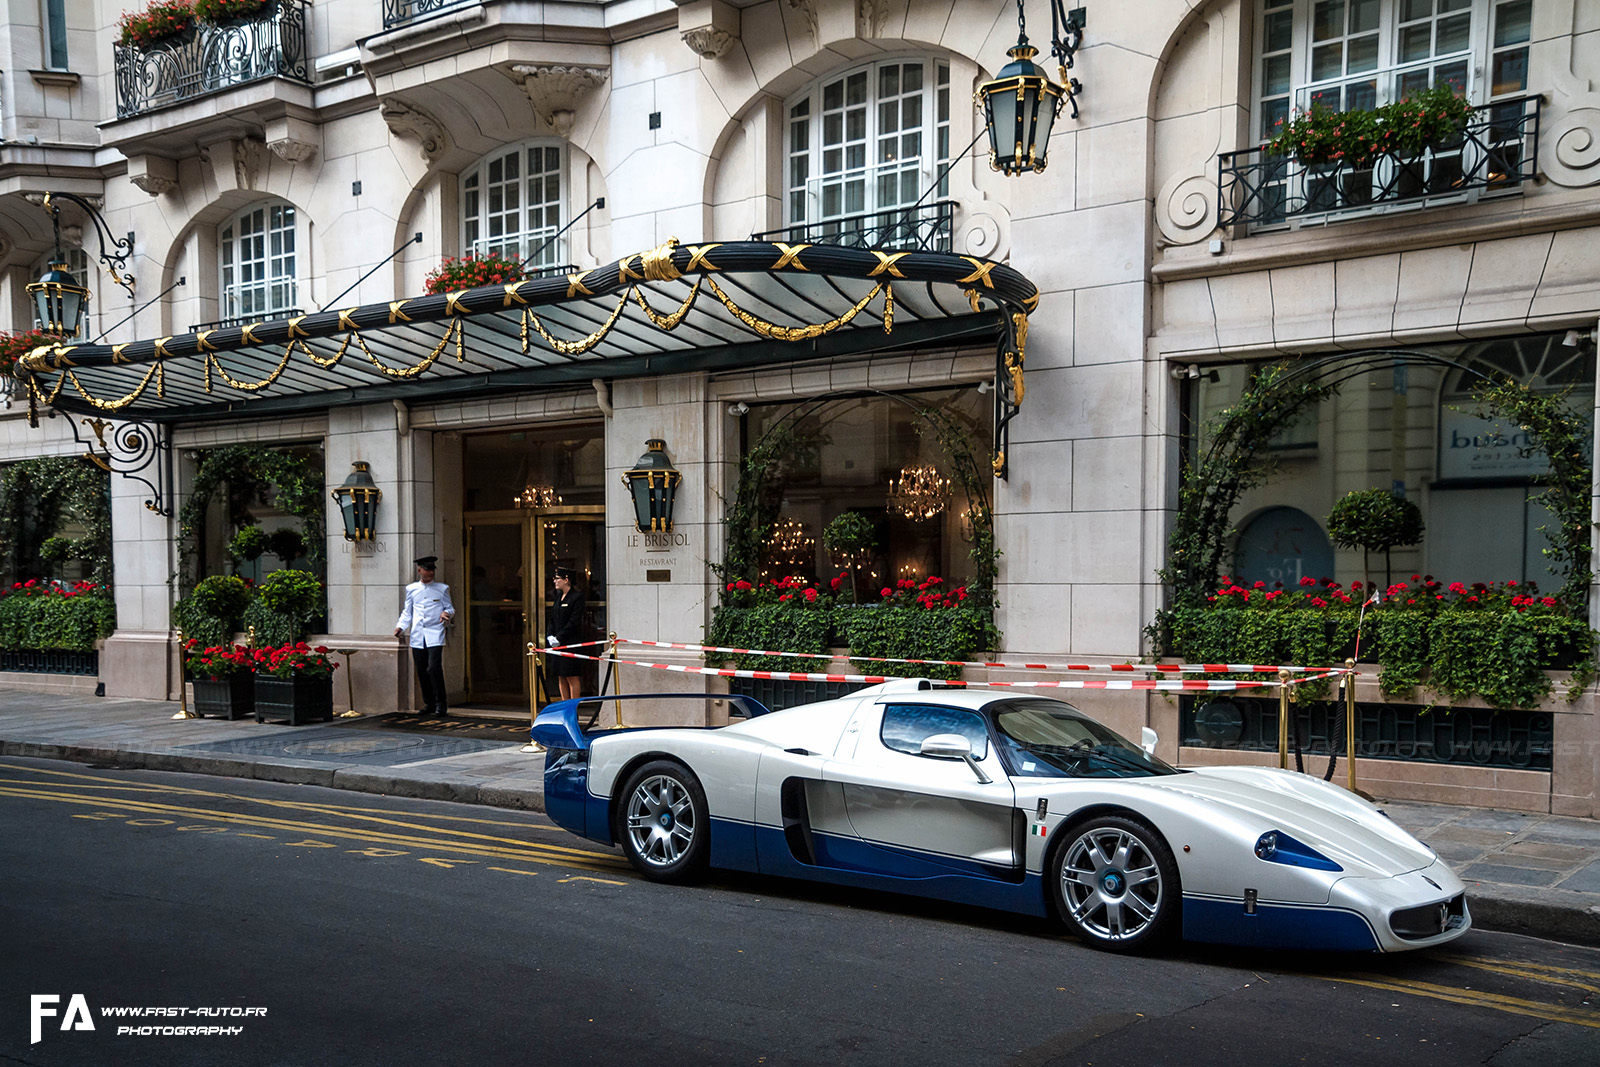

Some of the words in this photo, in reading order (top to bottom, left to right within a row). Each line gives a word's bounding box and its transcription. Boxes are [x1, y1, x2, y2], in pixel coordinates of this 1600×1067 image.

[341, 543, 350, 553] LE
[354, 541, 388, 554] BRISTOL
[627, 535, 639, 548] LE
[644, 533, 691, 547] BRISTOL
[418, 719, 532, 733] BRISTO
